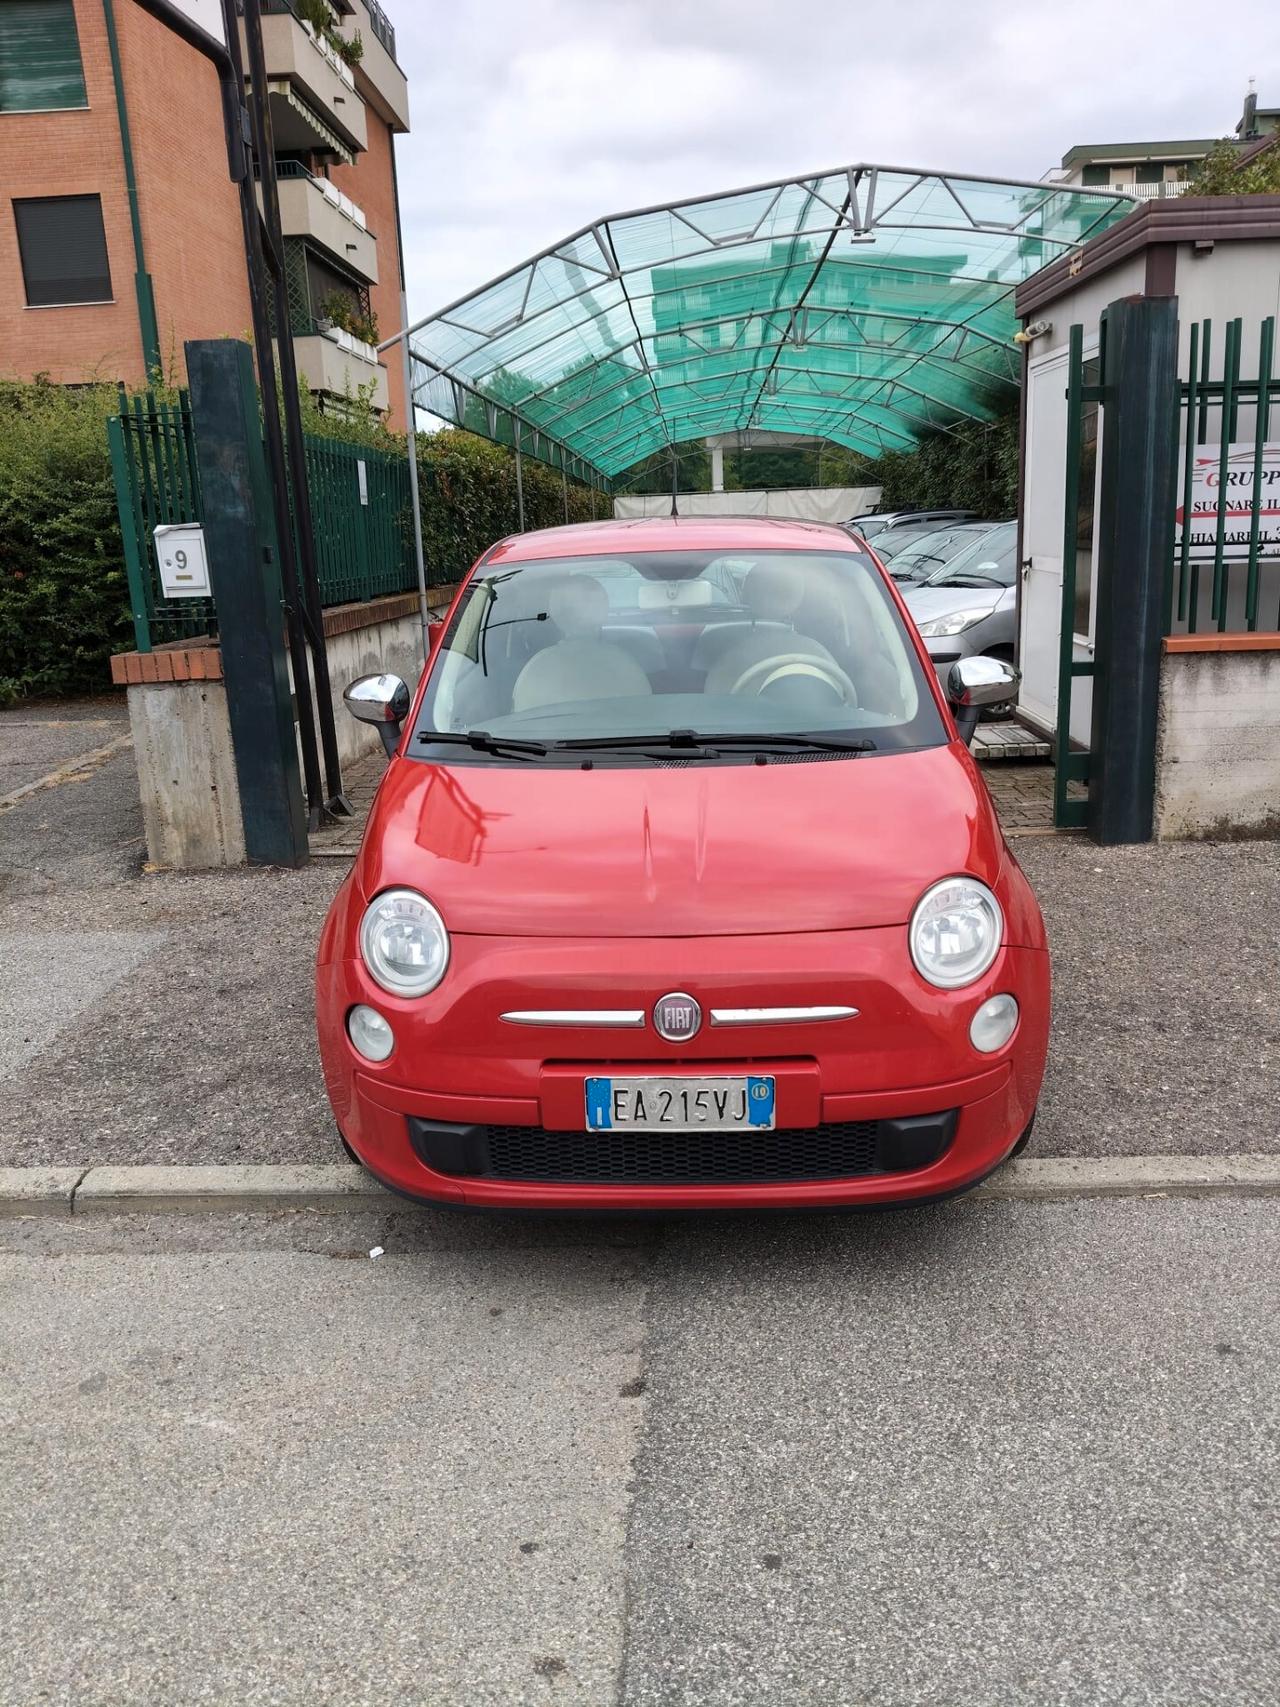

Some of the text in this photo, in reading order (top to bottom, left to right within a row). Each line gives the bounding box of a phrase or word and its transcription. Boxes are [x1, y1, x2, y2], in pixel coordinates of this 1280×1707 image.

[175, 550, 188, 569] 9
[664, 1007, 691, 1029] FIAT
[755, 1087, 766, 1097] 10
